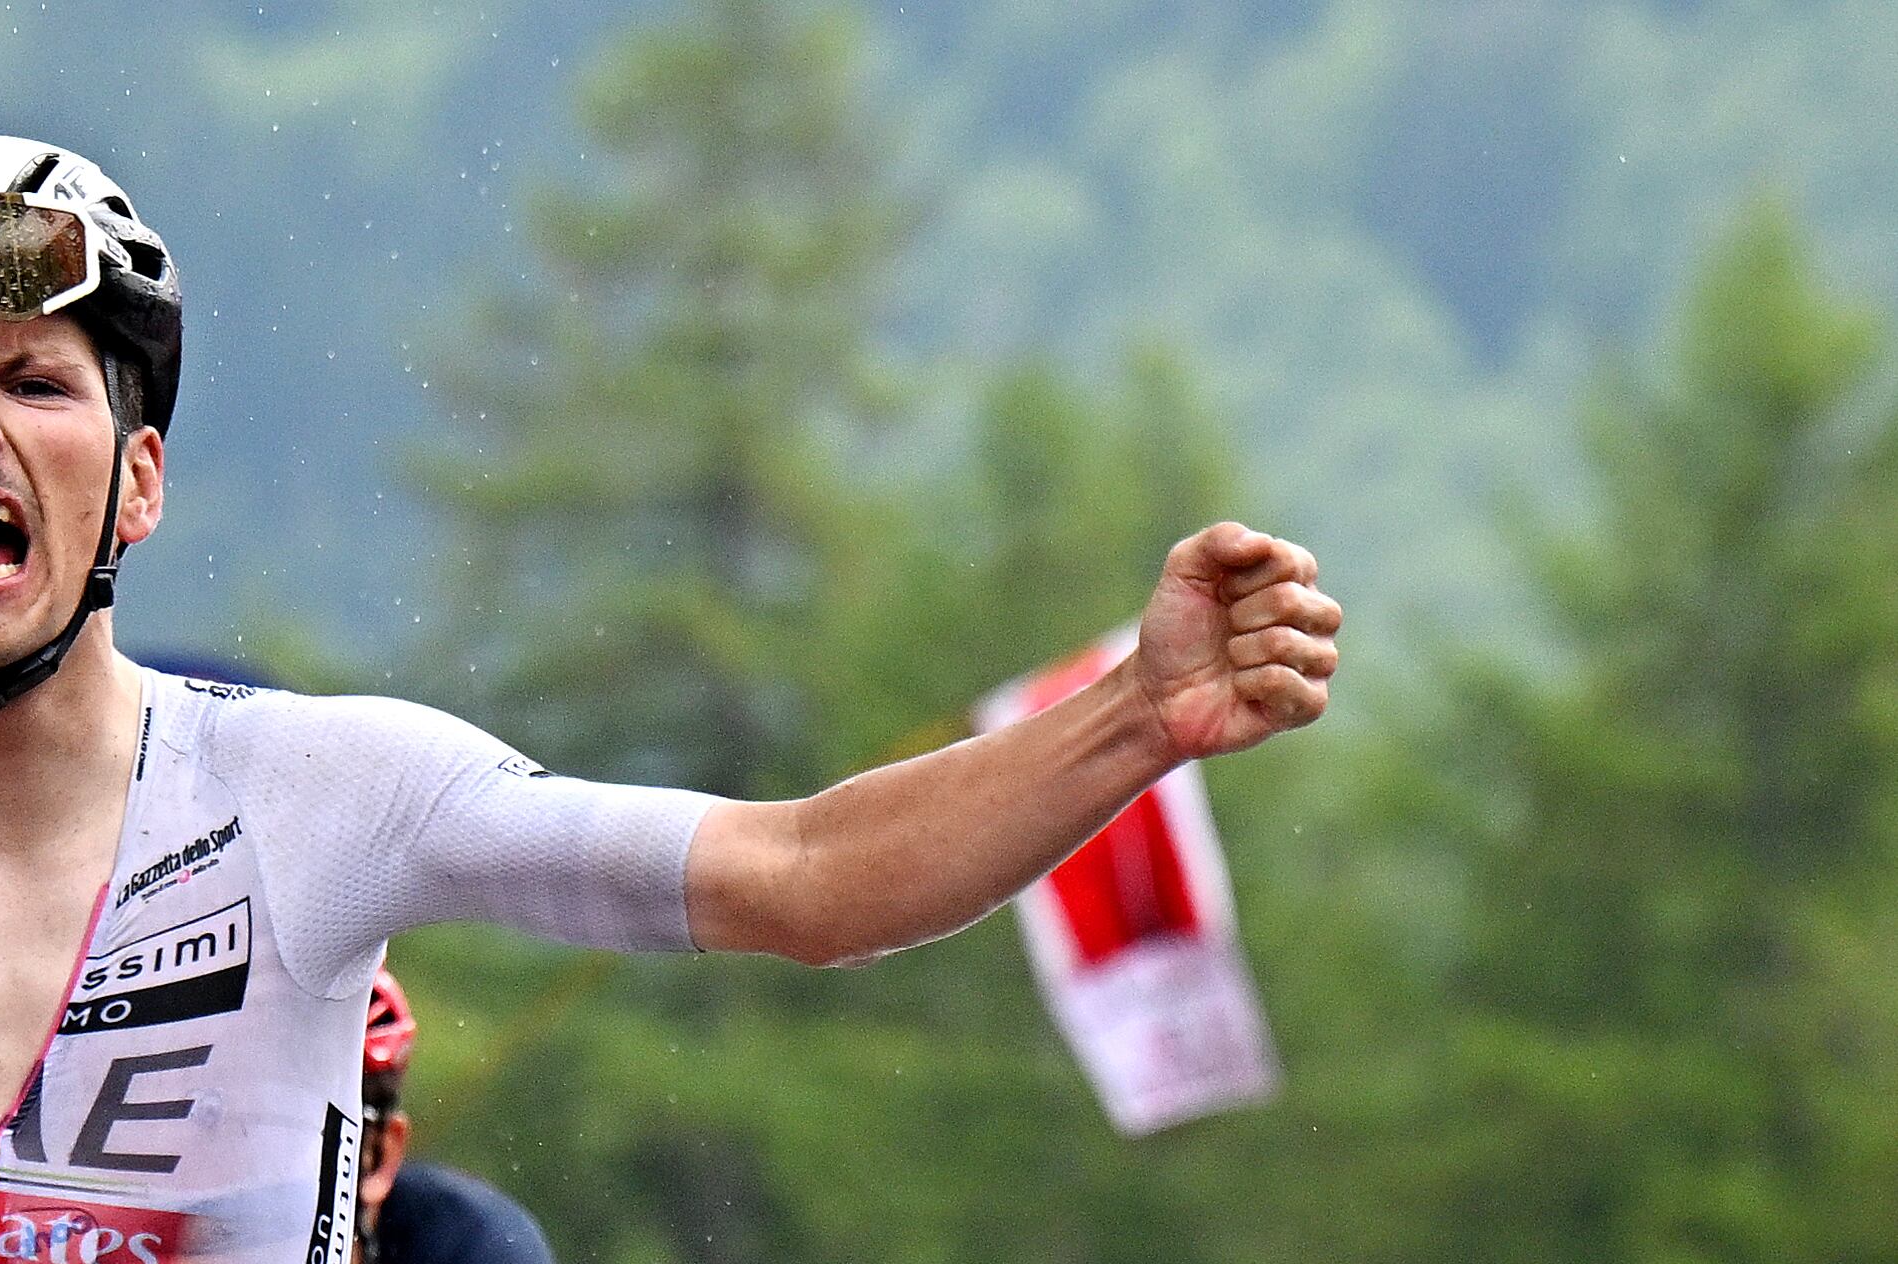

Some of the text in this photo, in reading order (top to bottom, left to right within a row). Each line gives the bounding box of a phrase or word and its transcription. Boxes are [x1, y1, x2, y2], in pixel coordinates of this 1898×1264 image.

[115, 815, 243, 909] La Gazzetta dello Sport
